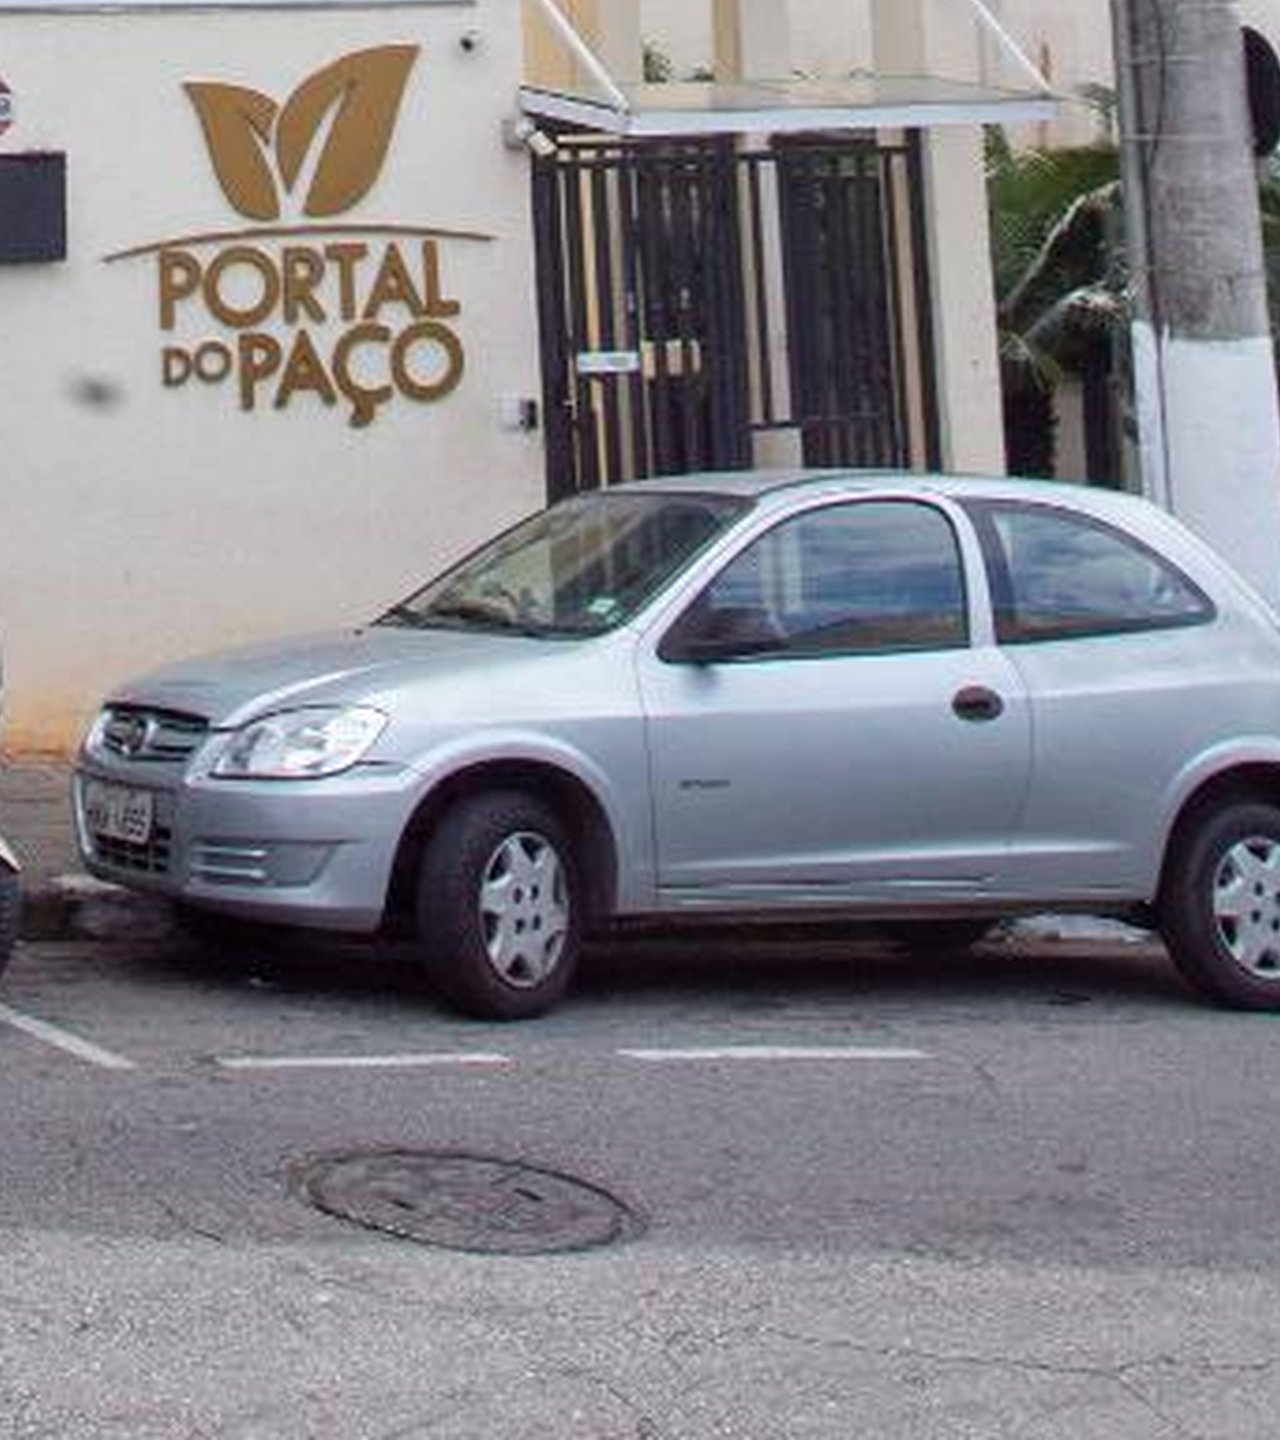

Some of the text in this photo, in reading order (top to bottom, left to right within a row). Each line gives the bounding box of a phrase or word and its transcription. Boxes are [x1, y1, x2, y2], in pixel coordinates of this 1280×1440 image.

[158, 239, 462, 331] PORTAL
[161, 320, 465, 429] DO PAÇO
